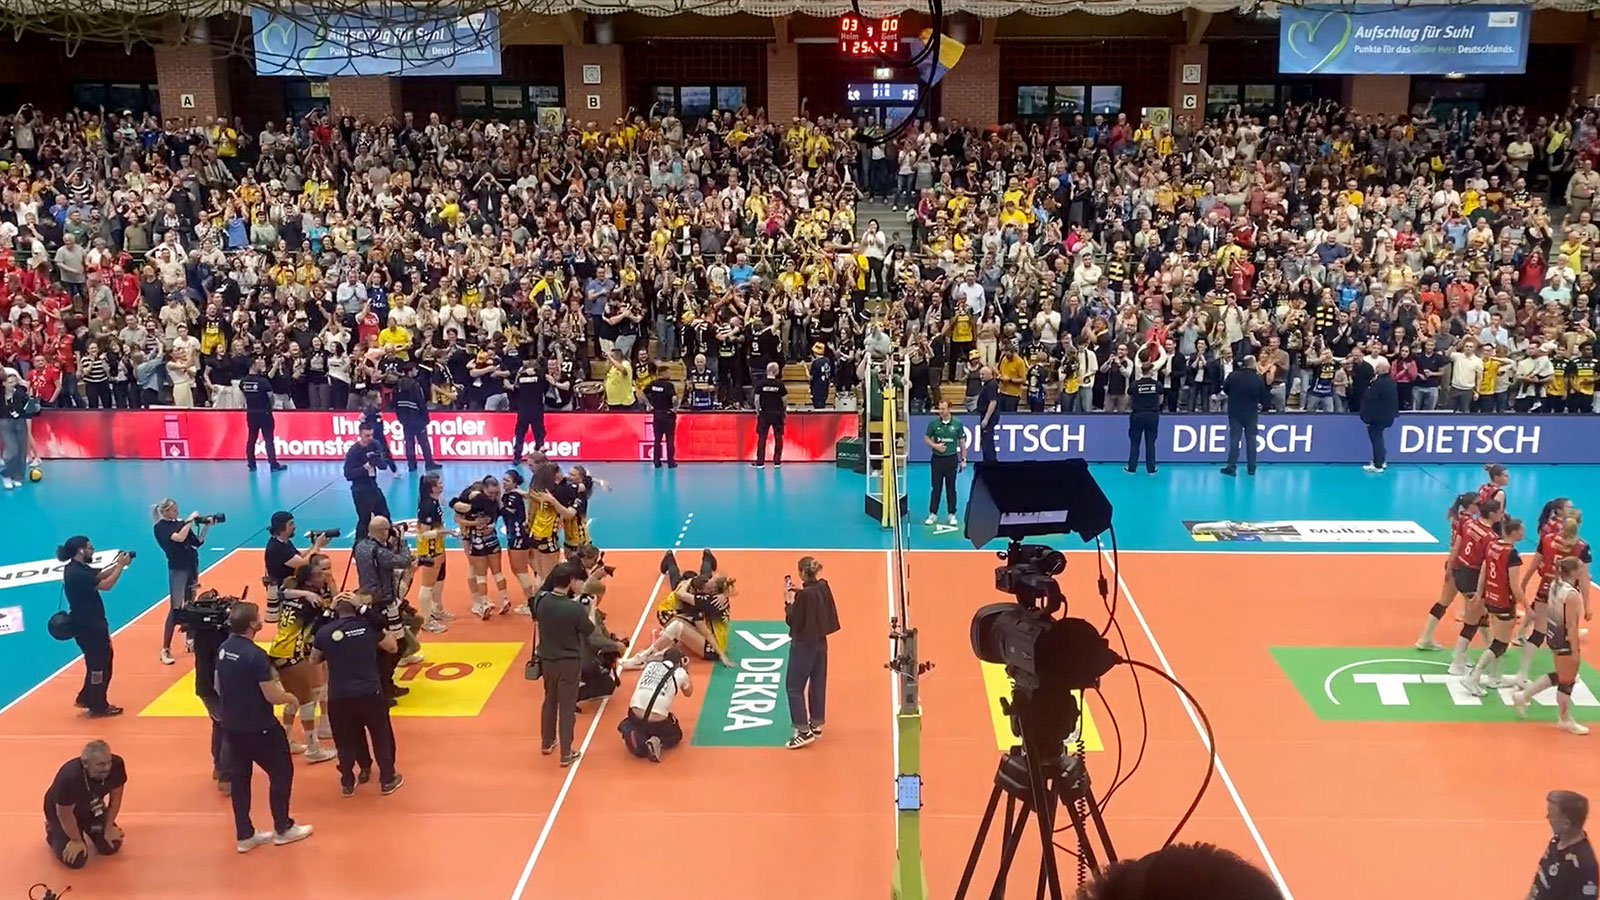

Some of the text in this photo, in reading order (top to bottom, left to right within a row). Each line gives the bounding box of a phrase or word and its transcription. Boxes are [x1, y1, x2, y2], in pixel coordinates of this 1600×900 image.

[842, 18, 858, 31] 03
[881, 19, 898, 31] 00
[1354, 25, 1475, 41] Aufschlag für Suhl
[1354, 45, 1382, 53] Punkte
[1383, 45, 1395, 53] für
[183, 95, 193, 106] A
[589, 96, 598, 107] B
[1185, 96, 1195, 107] C
[561, 361, 573, 373] 27
[1172, 424, 1313, 453] DIESCH
[1400, 425, 1541, 454] DIETSCH
[1464, 541, 1474, 555] 6
[1489, 561, 1498, 579] 8
[723, 657, 784, 732] DEKRA
